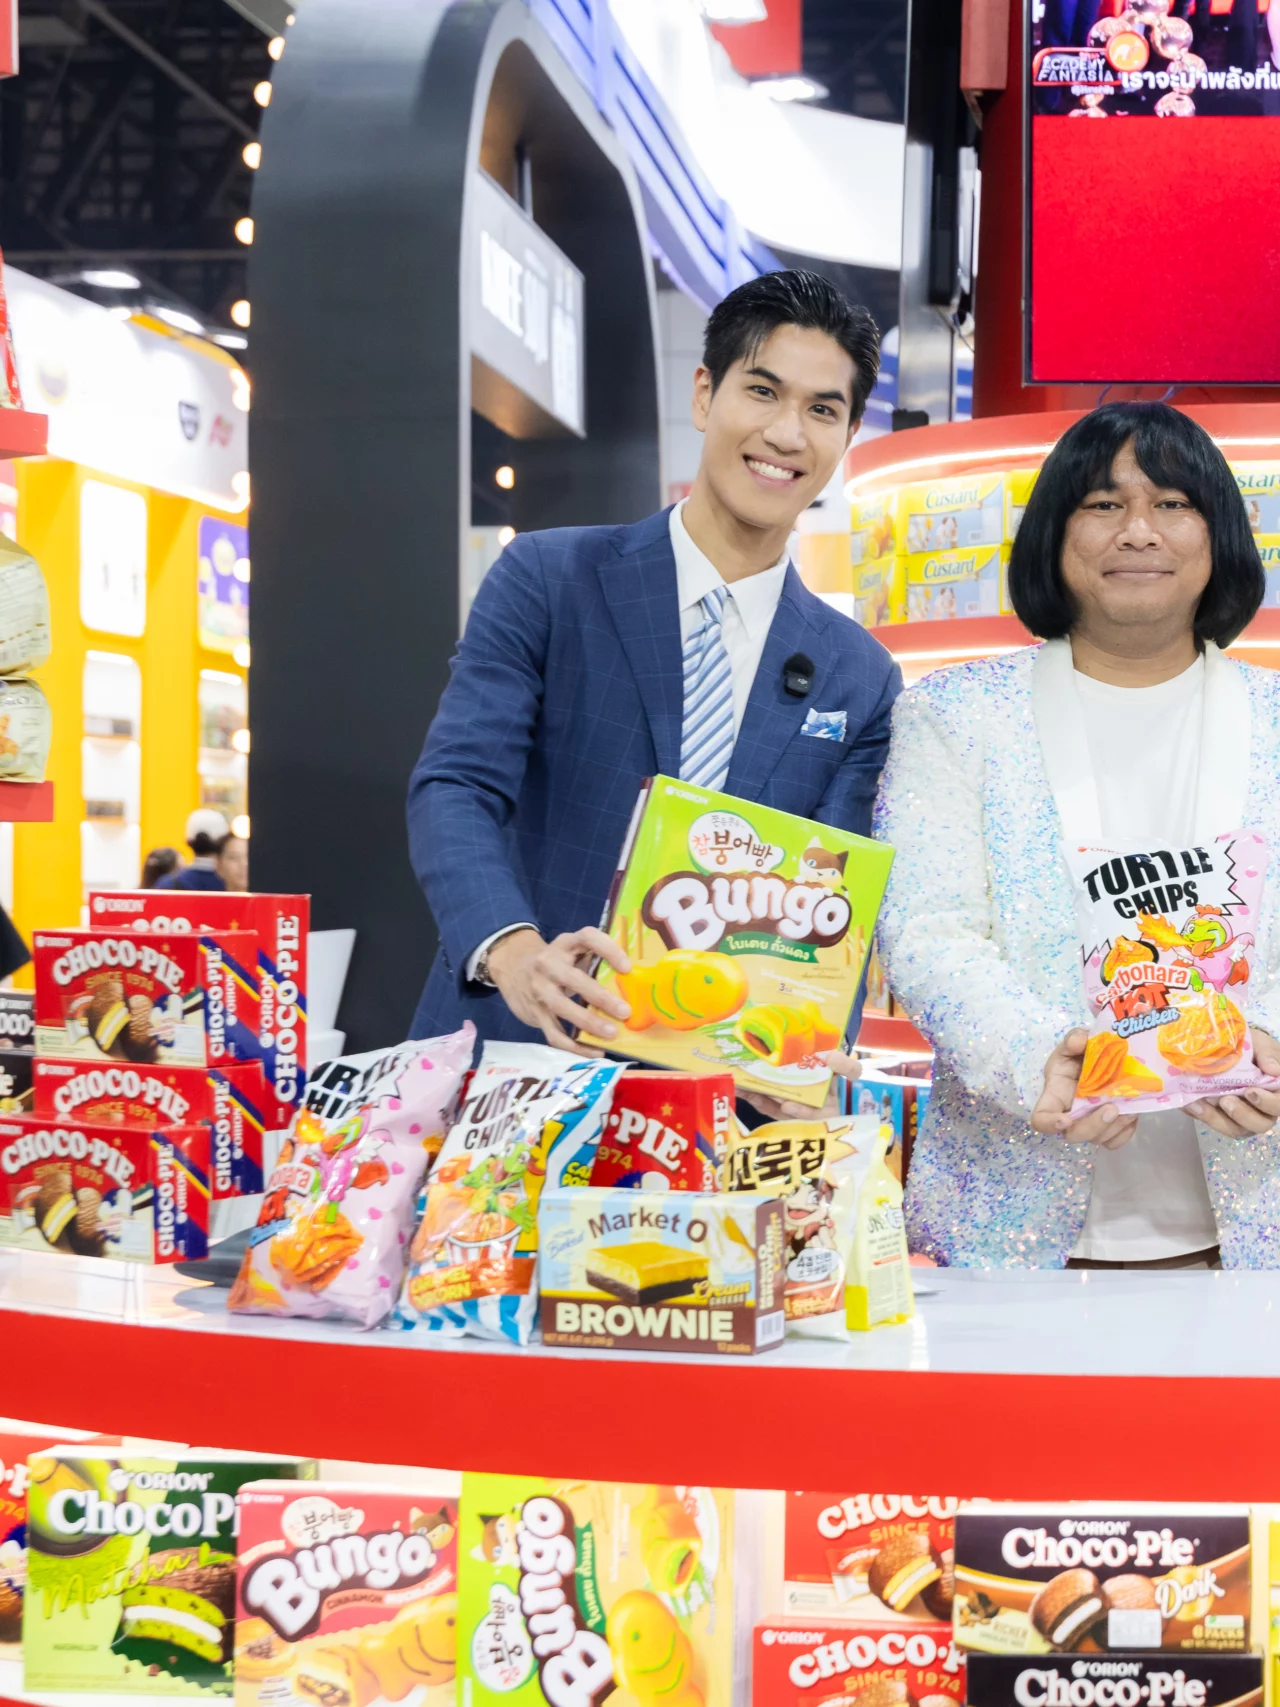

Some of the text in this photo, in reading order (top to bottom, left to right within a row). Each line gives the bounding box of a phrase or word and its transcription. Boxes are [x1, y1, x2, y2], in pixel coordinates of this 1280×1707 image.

[1038, 69, 1113, 82] FANTASIA
[926, 484, 979, 509] Custard
[924, 555, 976, 579] Custard
[1083, 847, 1214, 903] TURTLE
[652, 877, 849, 951] Bungo
[1114, 881, 1199, 919] CHIPS
[1095, 964, 1187, 1004] Carbonara
[1110, 982, 1168, 1021] HOT
[1112, 1007, 1180, 1038] Chicken
[588, 1207, 708, 1243] Market O
[556, 1302, 734, 1341] BROWNIE
[134, 1472, 209, 1492] ORION
[48, 1488, 239, 1538] ChocoPi
[1075, 1520, 1130, 1536] ORION
[869, 1523, 930, 1542] SINCE
[43, 1548, 193, 1620] Matcha
[247, 1532, 433, 1636] Bungo
[520, 1498, 614, 1707] Bungo
[1155, 1569, 1225, 1619] Dark
[1205, 1627, 1245, 1639] PACKS
[844, 1670, 961, 1693] SINCE 1974
[1088, 1662, 1143, 1677] ORION
